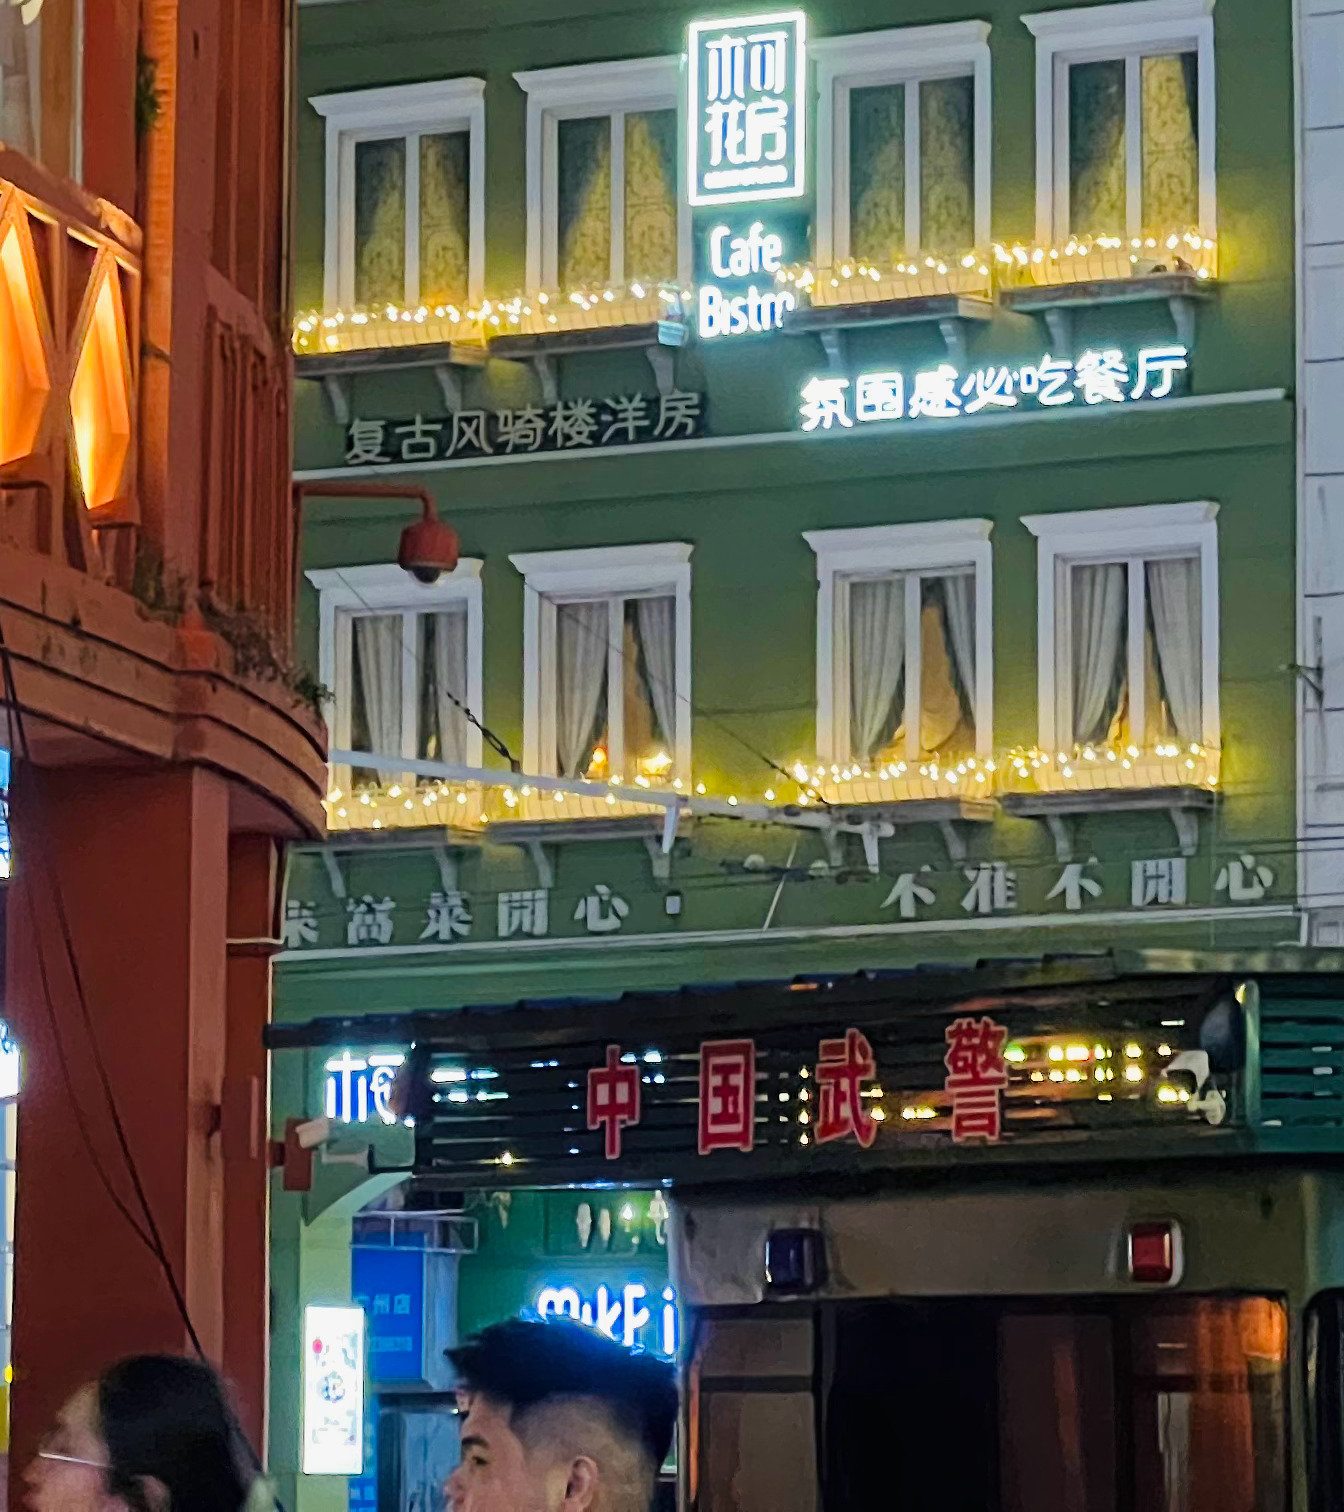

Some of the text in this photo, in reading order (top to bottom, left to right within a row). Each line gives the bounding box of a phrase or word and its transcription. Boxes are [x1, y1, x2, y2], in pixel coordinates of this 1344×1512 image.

[710, 221, 783, 279] Cafe
[344, 390, 703, 466] 复古风骑楼洋房
[800, 347, 1189, 433] 氛围感必吃餐厅
[879, 853, 1274, 919] 不准不開心
[586, 1015, 1012, 1160] 中国武警
